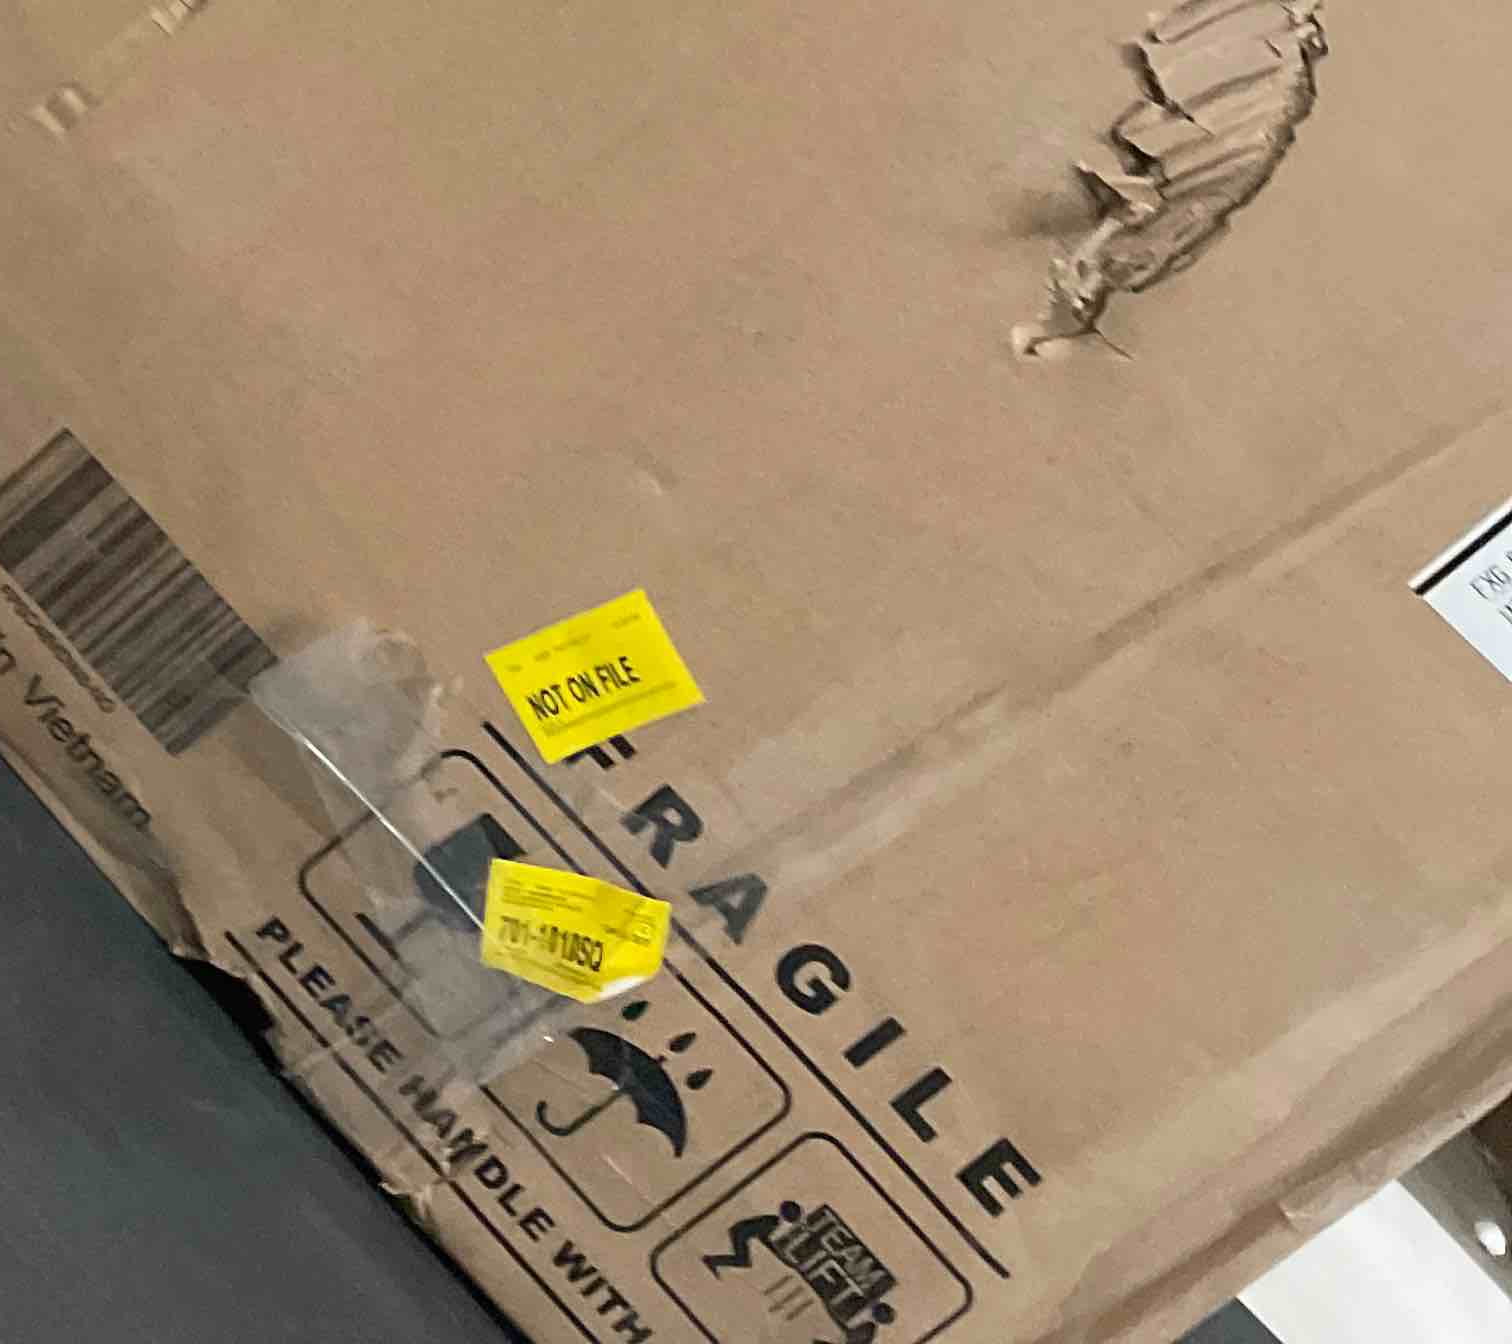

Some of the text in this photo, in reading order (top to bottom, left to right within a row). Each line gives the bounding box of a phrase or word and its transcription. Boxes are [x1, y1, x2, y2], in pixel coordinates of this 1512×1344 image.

[525, 683, 570, 722] NOT
[565, 671, 601, 704] ON
[594, 655, 642, 693] FILE
[23, 674, 152, 828] Vietnam
[562, 733, 1043, 1216] FRAGILE
[255, 916, 404, 1075] PLEASE
[398, 1074, 557, 1244] HANDLE
[551, 1239, 653, 1344] WITH
[784, 1230, 865, 1308] LIFT
[803, 1207, 885, 1290] TEAM
